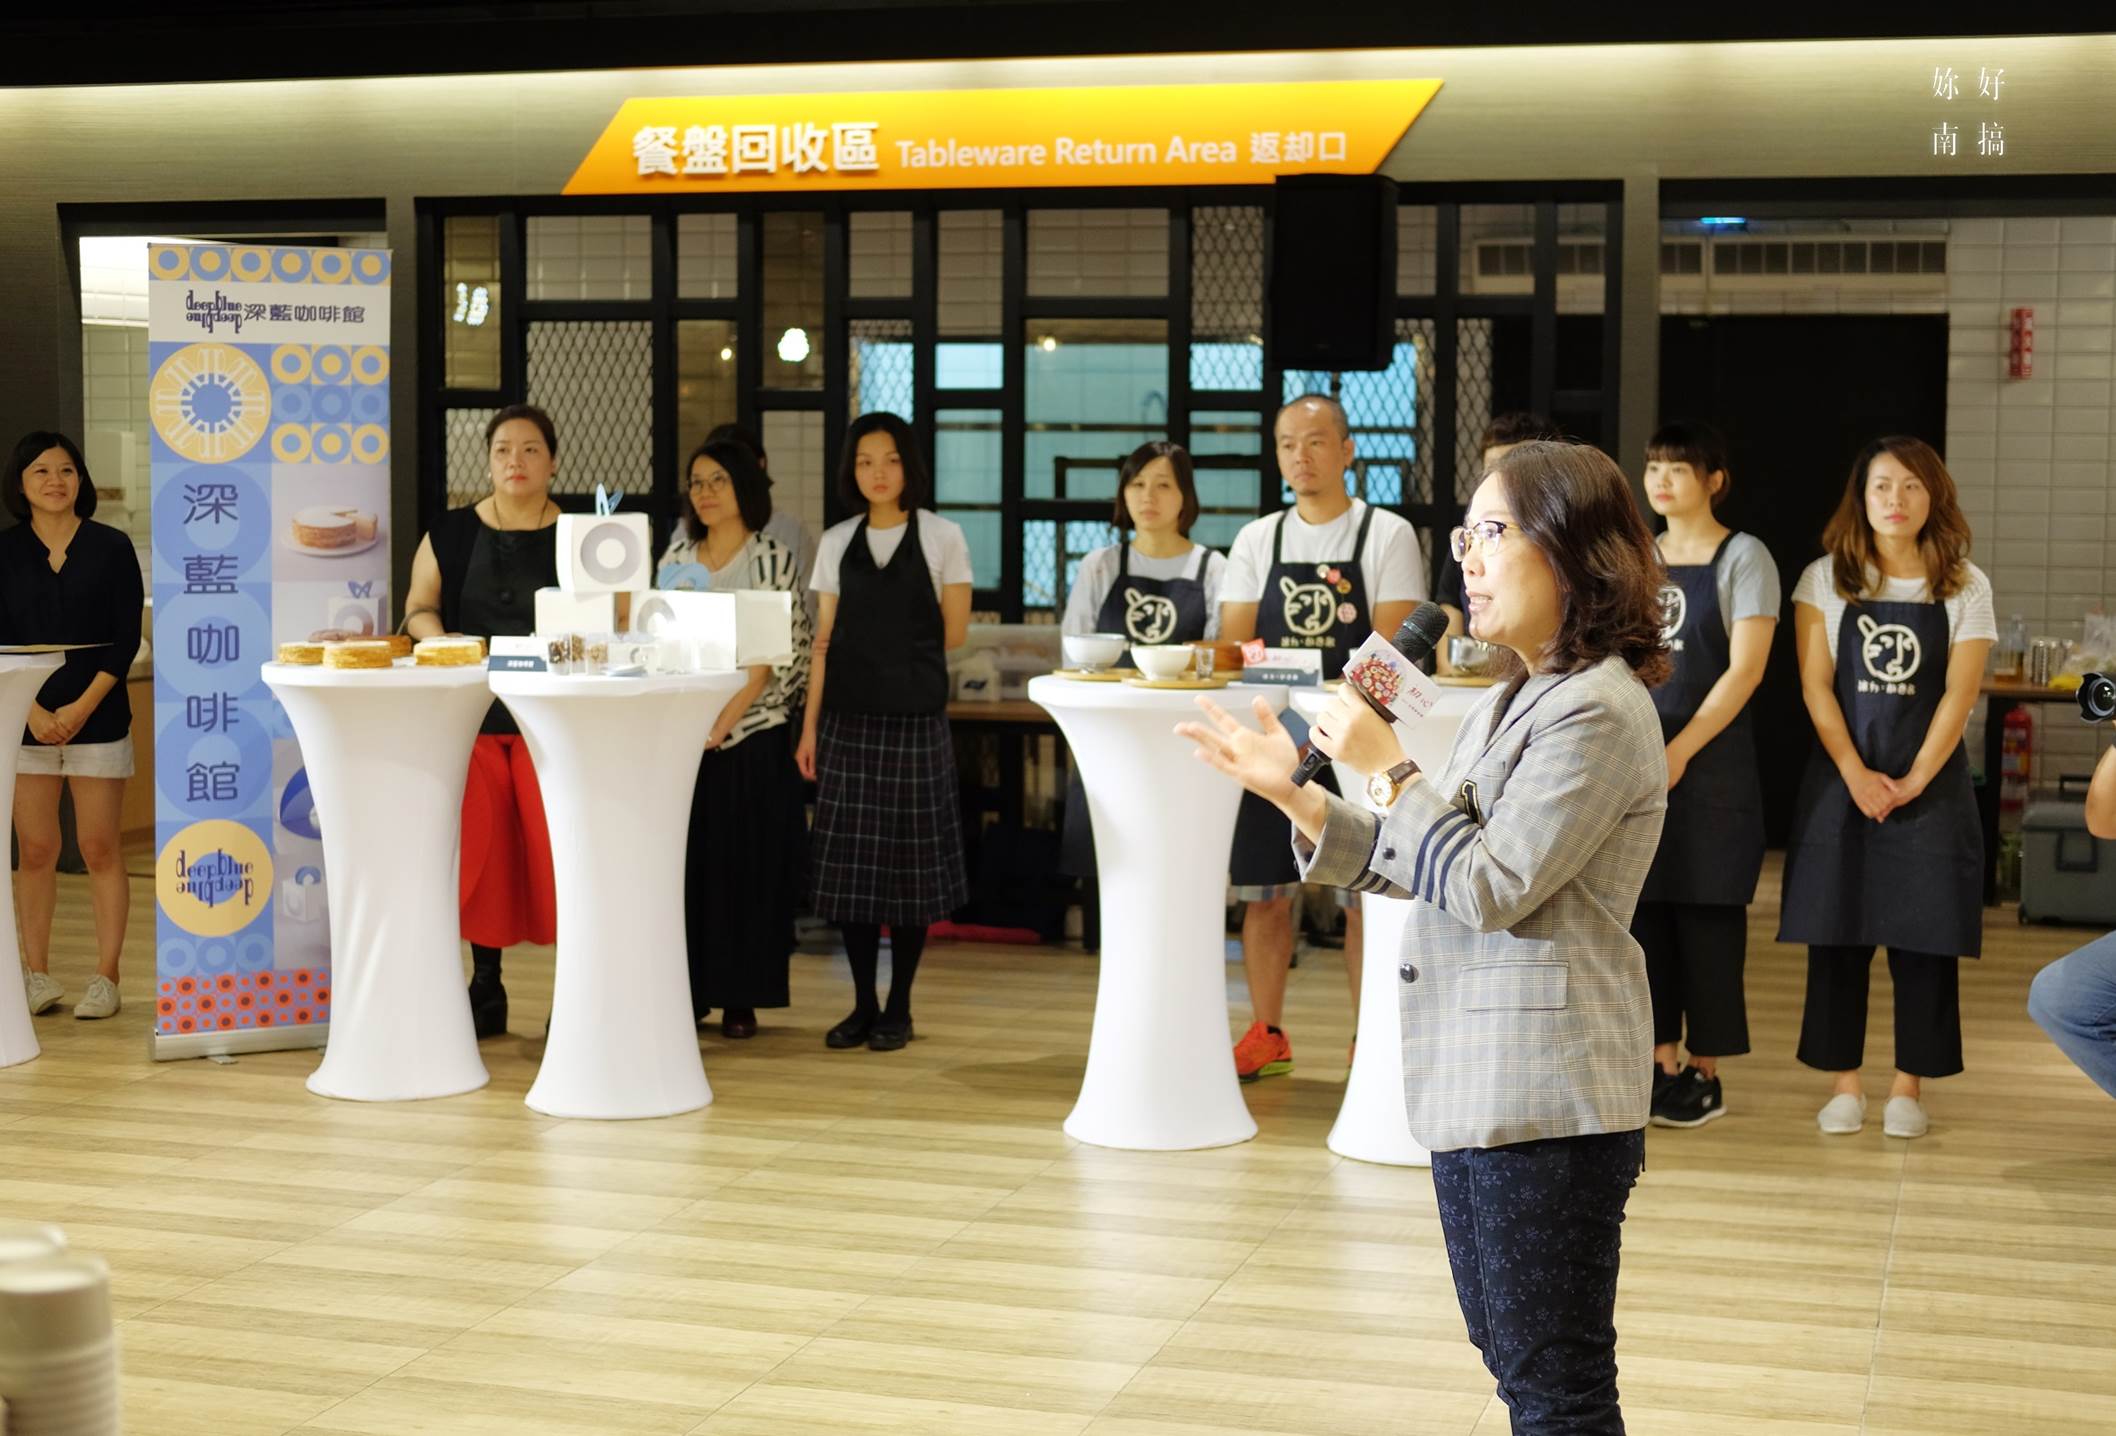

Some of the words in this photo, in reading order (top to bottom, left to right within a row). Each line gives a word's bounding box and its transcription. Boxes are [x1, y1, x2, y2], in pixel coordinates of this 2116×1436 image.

[632, 121, 880, 176] 餐盤回收區
[896, 138, 1047, 168] Tableware
[1055, 137, 1158, 166] Return
[1165, 135, 1238, 164] Area
[1250, 130, 1347, 164] 返却口
[243, 303, 366, 323] 深藍咖啡館
[182, 483, 241, 802] 深藍咖啡館
